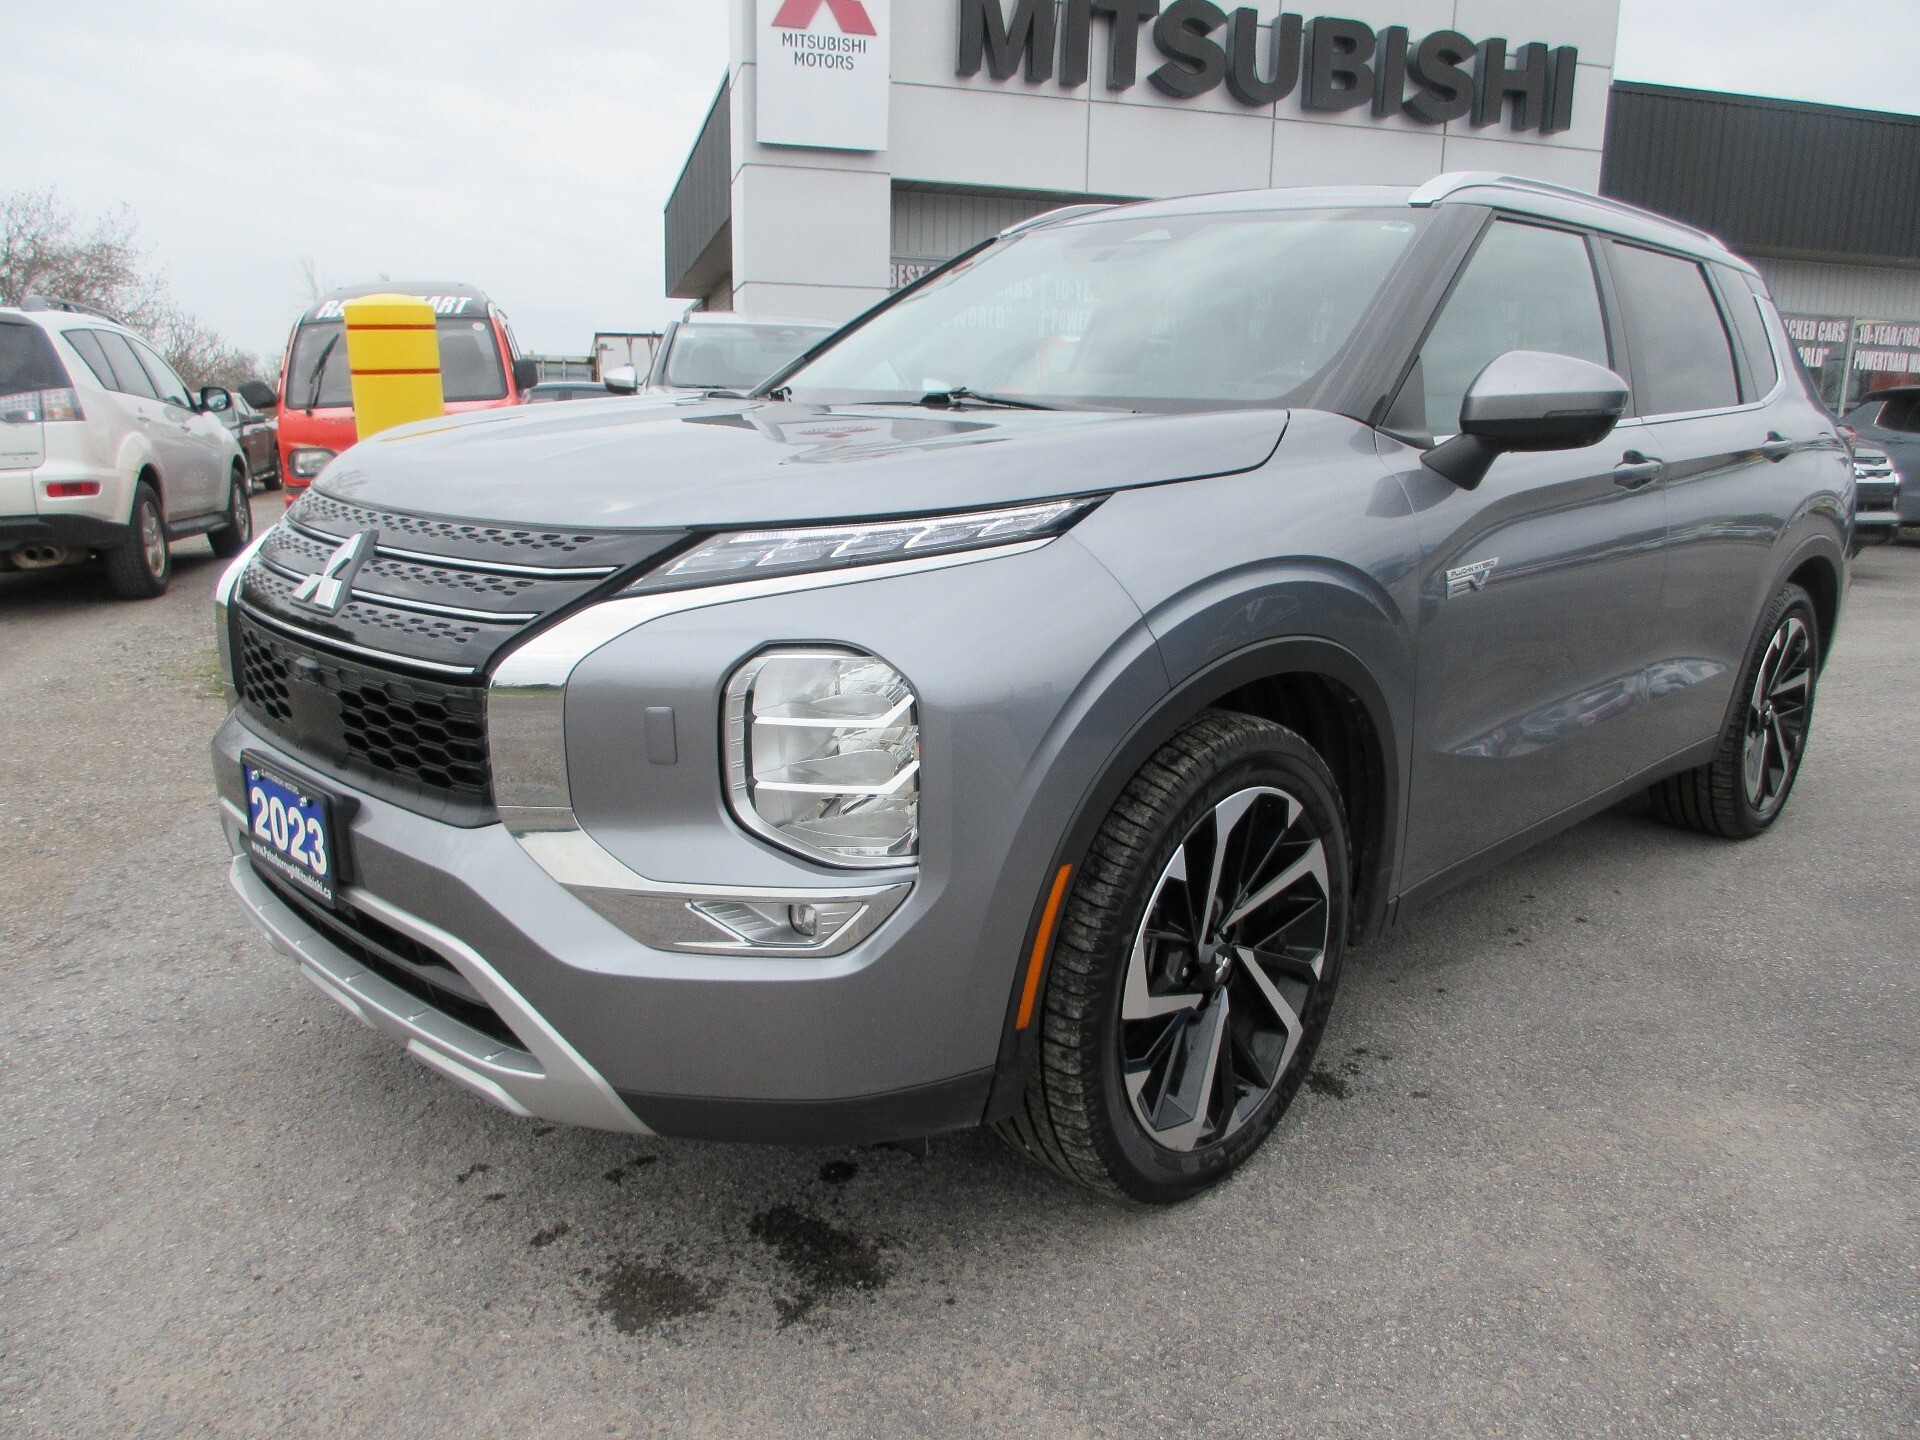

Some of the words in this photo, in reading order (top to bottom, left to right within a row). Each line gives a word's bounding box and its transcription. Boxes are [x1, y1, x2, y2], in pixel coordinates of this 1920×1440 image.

[781, 32, 867, 54] MITSUBISHI
[793, 52, 855, 71] MOTORS
[955, 0, 1577, 135] MITSUBISHI
[1818, 321, 1846, 343] CARS
[251, 786, 327, 875] 2023
